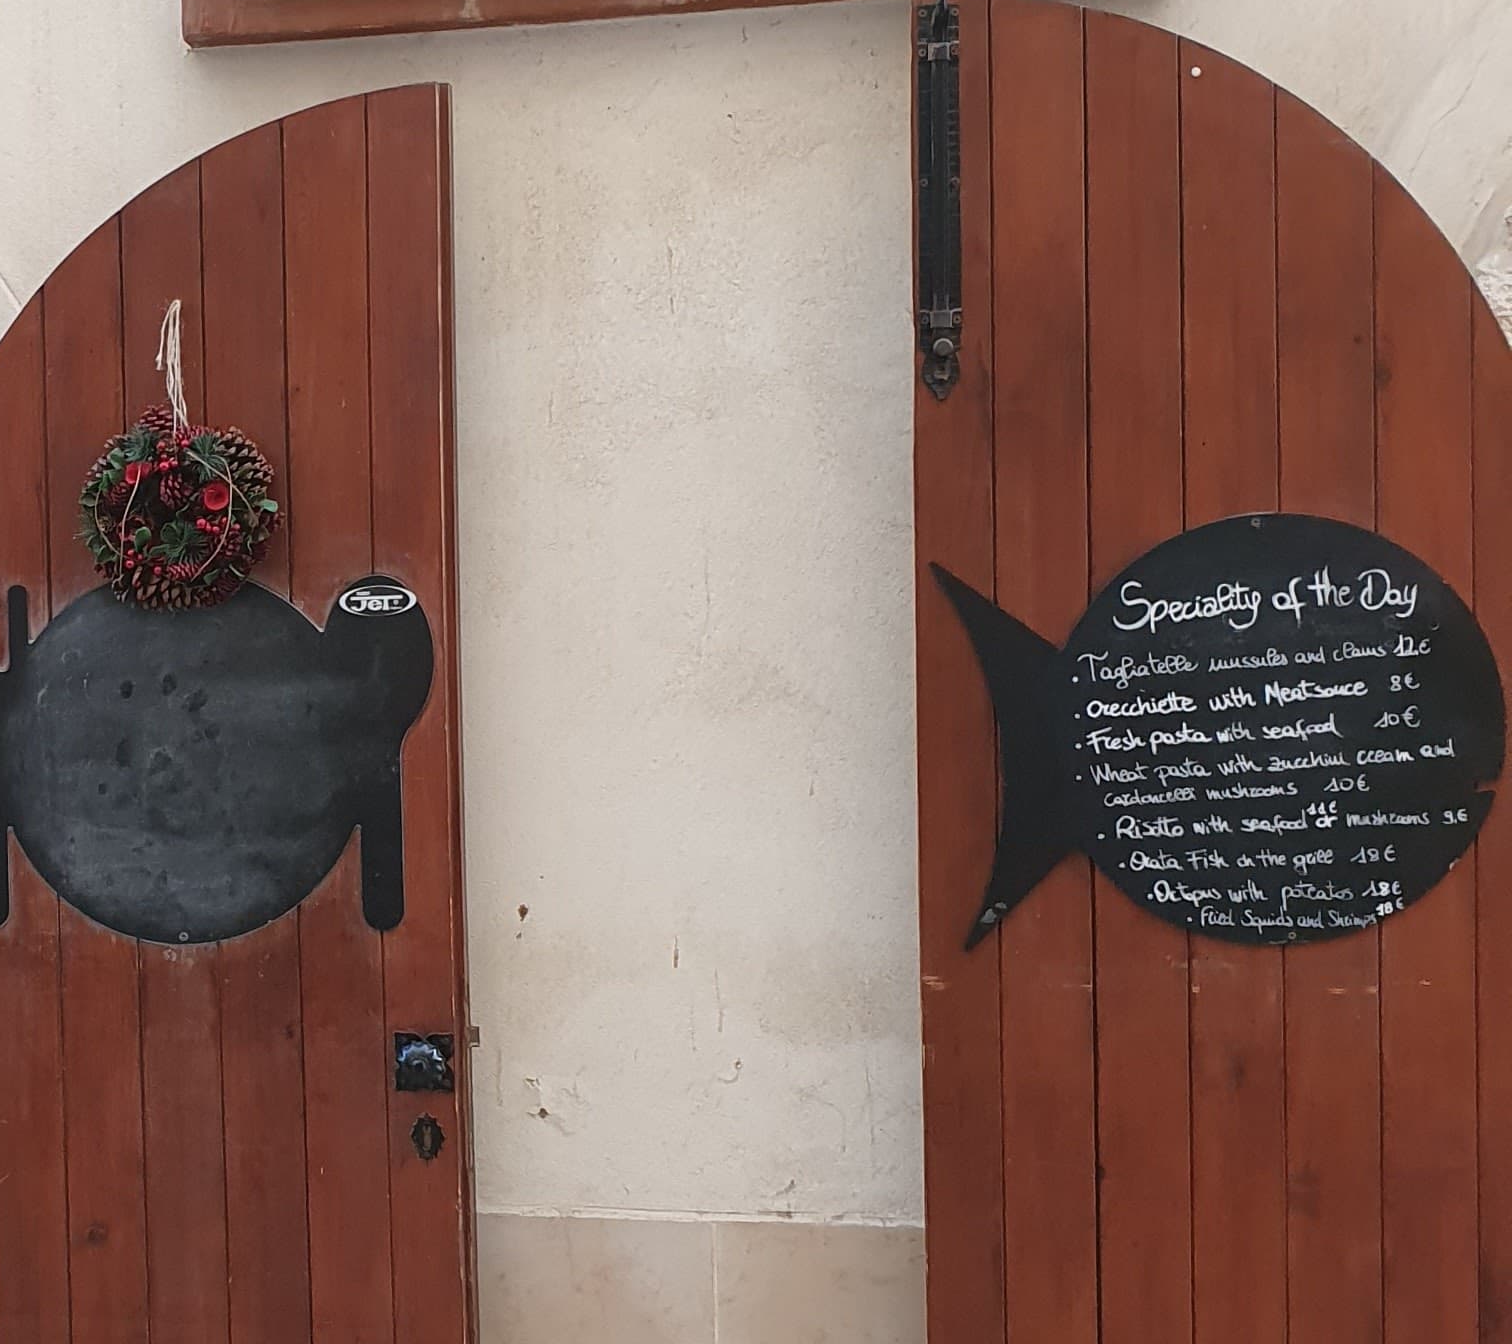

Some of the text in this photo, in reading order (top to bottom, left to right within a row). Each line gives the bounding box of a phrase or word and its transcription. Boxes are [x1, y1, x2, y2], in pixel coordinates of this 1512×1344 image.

[1112, 566, 1417, 632] Speciality of the Day
[1077, 651, 1198, 689] Tagliatelle
[1295, 646, 1325, 664] and
[1087, 692, 1197, 718] Orecchiette
[1209, 687, 1256, 711] with
[1087, 705, 1420, 755] Fresh pasta with seafood 10€
[1090, 762, 1149, 785] Wheat
[1154, 757, 1212, 787] pasta
[1218, 753, 1263, 776] with
[1357, 749, 1414, 764] cream
[1420, 739, 1456, 757] and
[1206, 782, 1298, 801] mushrooms
[1324, 774, 1370, 792] 10€
[1116, 816, 1184, 839] Risotto
[1193, 814, 1233, 834] with
[1242, 814, 1308, 838] seafood
[1185, 848, 1229, 870] Fish
[1256, 848, 1287, 869] the
[1154, 880, 1222, 907] Octopus
[1228, 879, 1268, 903] with
[1201, 905, 1235, 926] Fried
[1297, 915, 1324, 928] and
